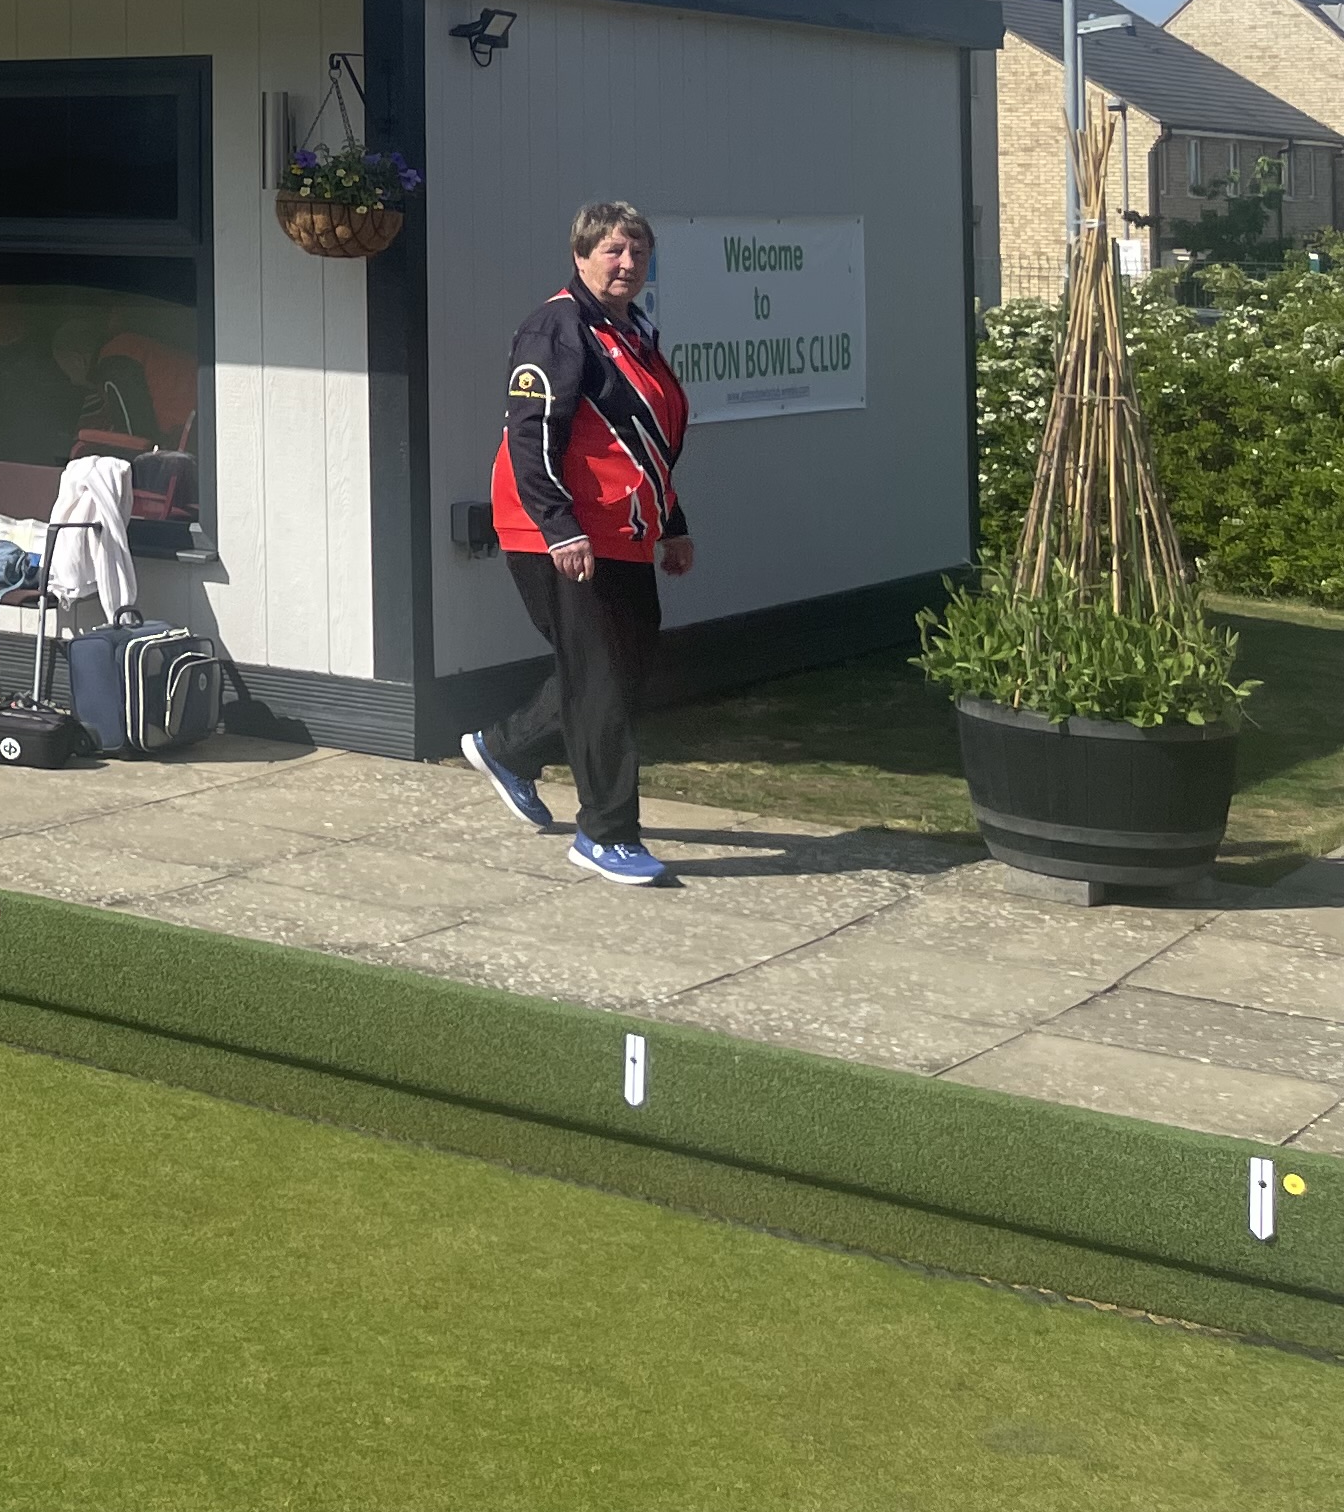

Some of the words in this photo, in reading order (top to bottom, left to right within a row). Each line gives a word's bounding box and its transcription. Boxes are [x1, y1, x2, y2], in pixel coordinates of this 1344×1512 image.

[723, 235, 804, 273] Welcome
[753, 286, 770, 320] to
[670, 340, 740, 383] GIRTON
[744, 335, 805, 378] BOWLS
[808, 332, 850, 372] CLUB
